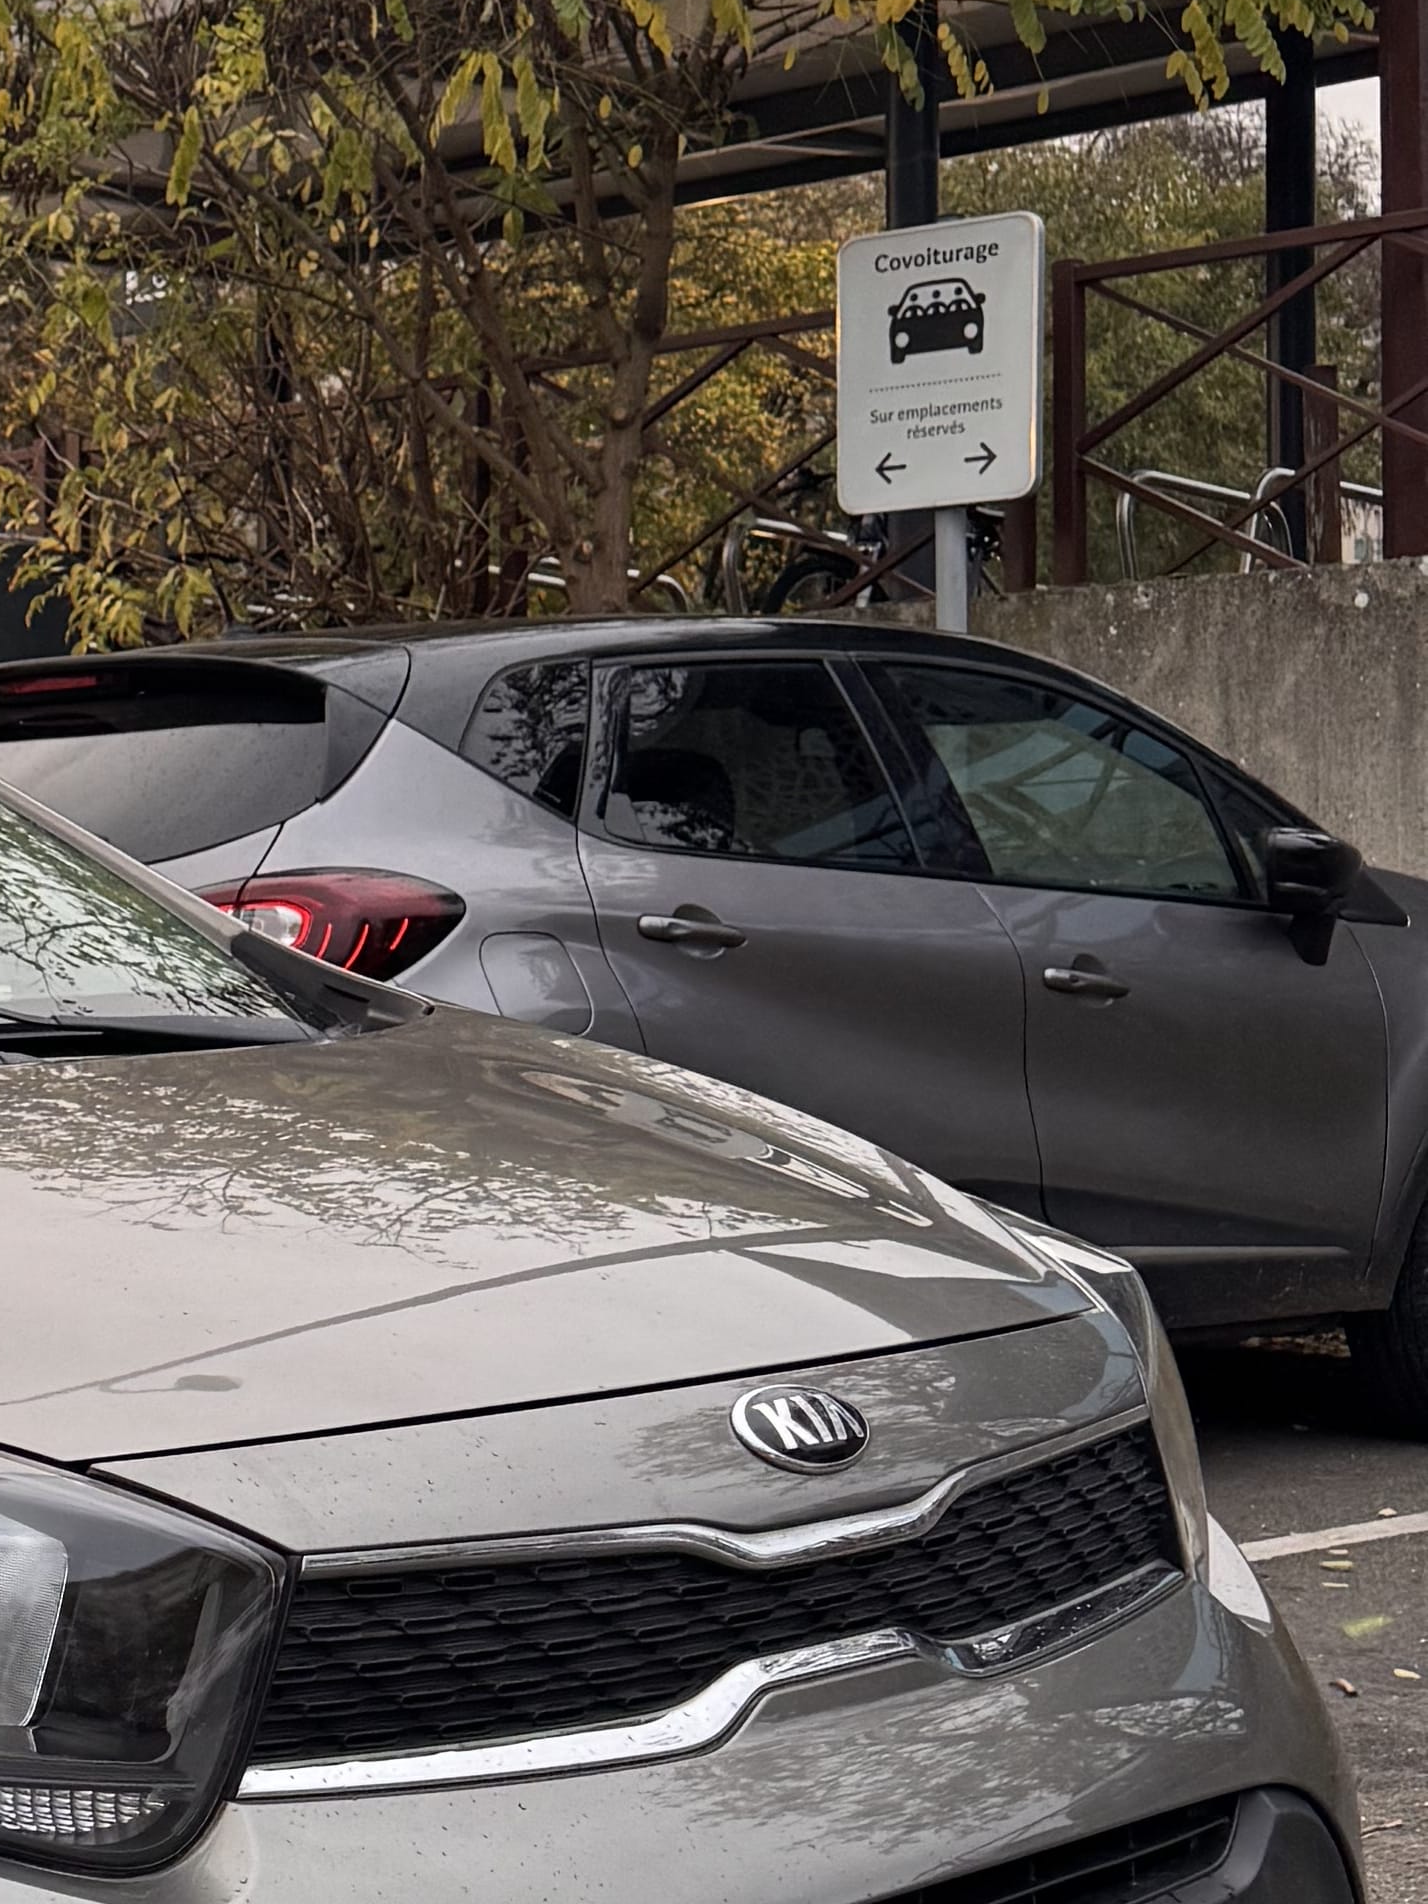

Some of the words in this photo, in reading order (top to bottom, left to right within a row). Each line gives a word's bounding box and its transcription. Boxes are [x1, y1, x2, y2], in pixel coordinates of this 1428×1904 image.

[874, 241, 1000, 273] Covoiturage
[869, 408, 894, 425] Sur
[897, 396, 1003, 422] emplacements
[906, 419, 966, 440] réservés
[750, 1391, 865, 1451] KIA
